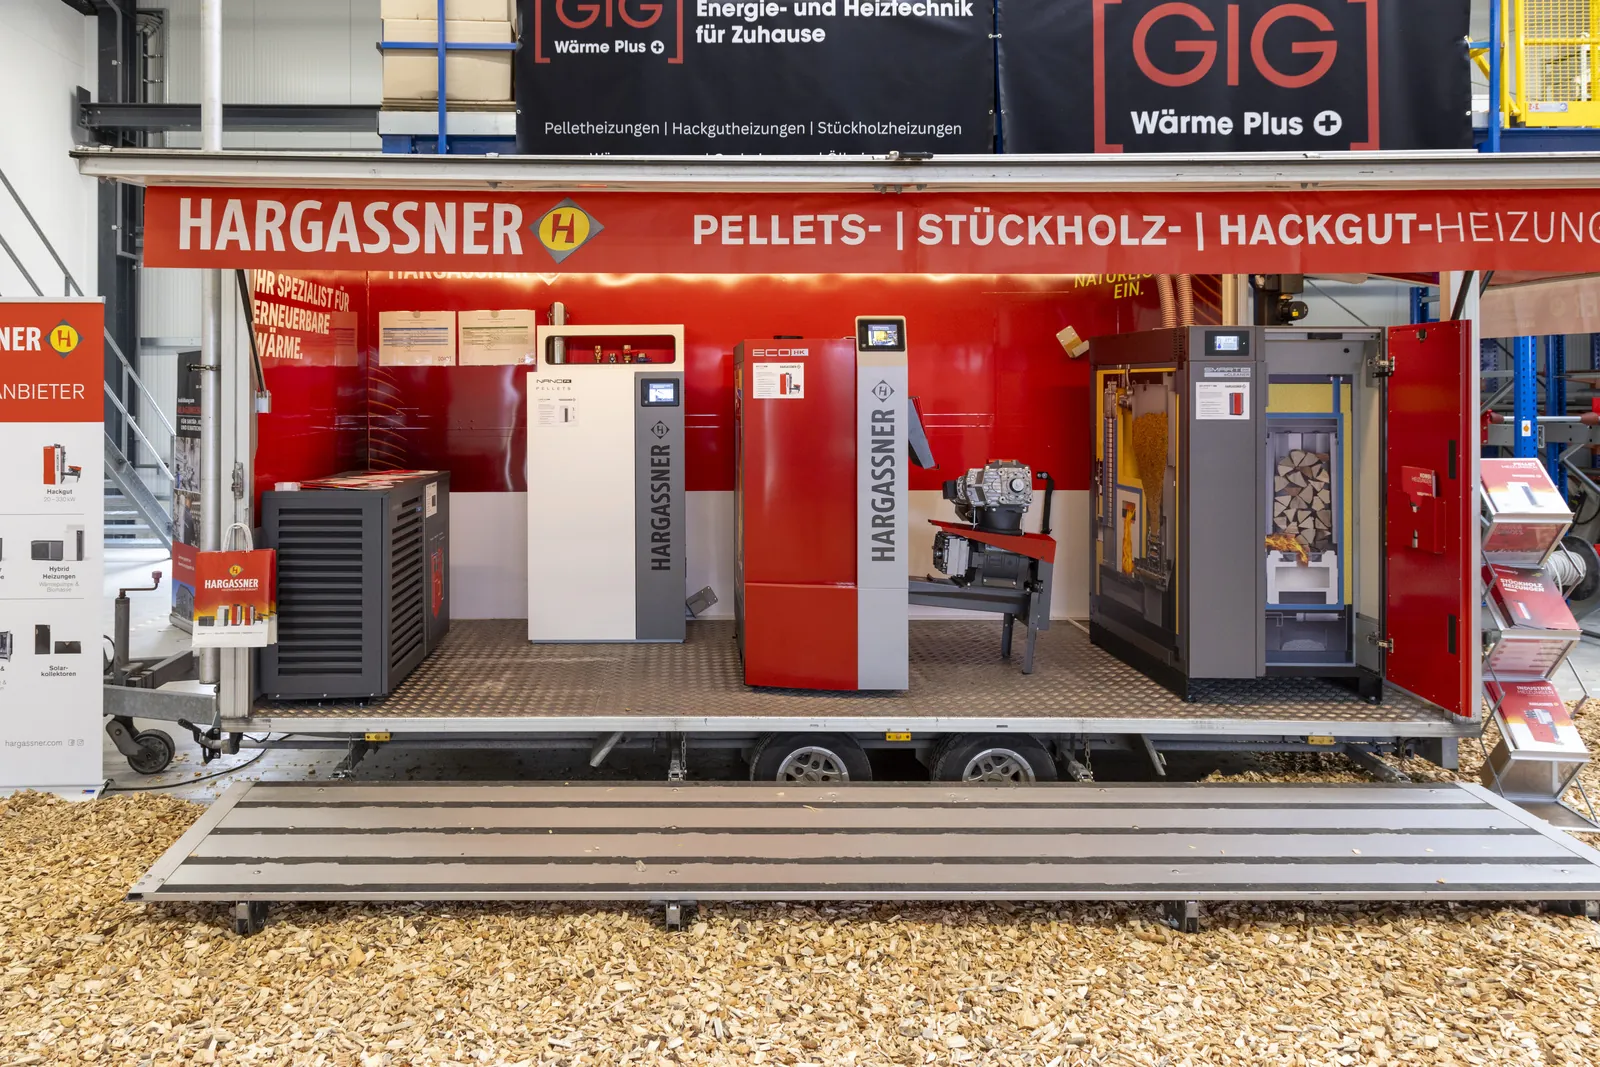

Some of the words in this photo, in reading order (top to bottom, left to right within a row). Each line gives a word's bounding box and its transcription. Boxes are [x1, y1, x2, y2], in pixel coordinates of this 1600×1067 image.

[555, 0, 664, 29] GIG
[696, 0, 787, 21] Energie-
[793, 0, 836, 17] und
[844, 0, 973, 18] Heiztechnik
[554, 39, 610, 54] Wärme
[615, 39, 646, 54] Plus
[696, 26, 727, 43] für
[732, 26, 826, 43] Zuhause
[1132, 2, 1338, 89] GIG
[544, 121, 660, 138] Pelletheizungen
[672, 121, 805, 138] Hackgutheizungen
[817, 120, 963, 138] Stückholzheizungen
[1130, 108, 1234, 136] Wärme
[1244, 110, 1304, 136] Plus
[179, 197, 524, 255] HARGASSNER
[692, 213, 882, 246] PELLETS-
[917, 206, 1182, 247] STÜCKHOLZ-
[253, 269, 276, 296] IHR
[277, 273, 334, 309] SPEZIALIST
[334, 285, 350, 313] FÜR
[1113, 281, 1144, 299] EIN.
[254, 299, 331, 335] ERNEUERBARE
[254, 326, 303, 360] WÄRME.
[752, 348, 791, 357] ECO
[0, 383, 85, 400] NBIETER
[46, 488, 73, 496] Hackgut
[871, 409, 896, 562] HARGASSNER
[650, 444, 671, 571] HARGASSNER
[204, 578, 259, 589] HARGASSNER
[4, 738, 63, 749] hargassner.com
